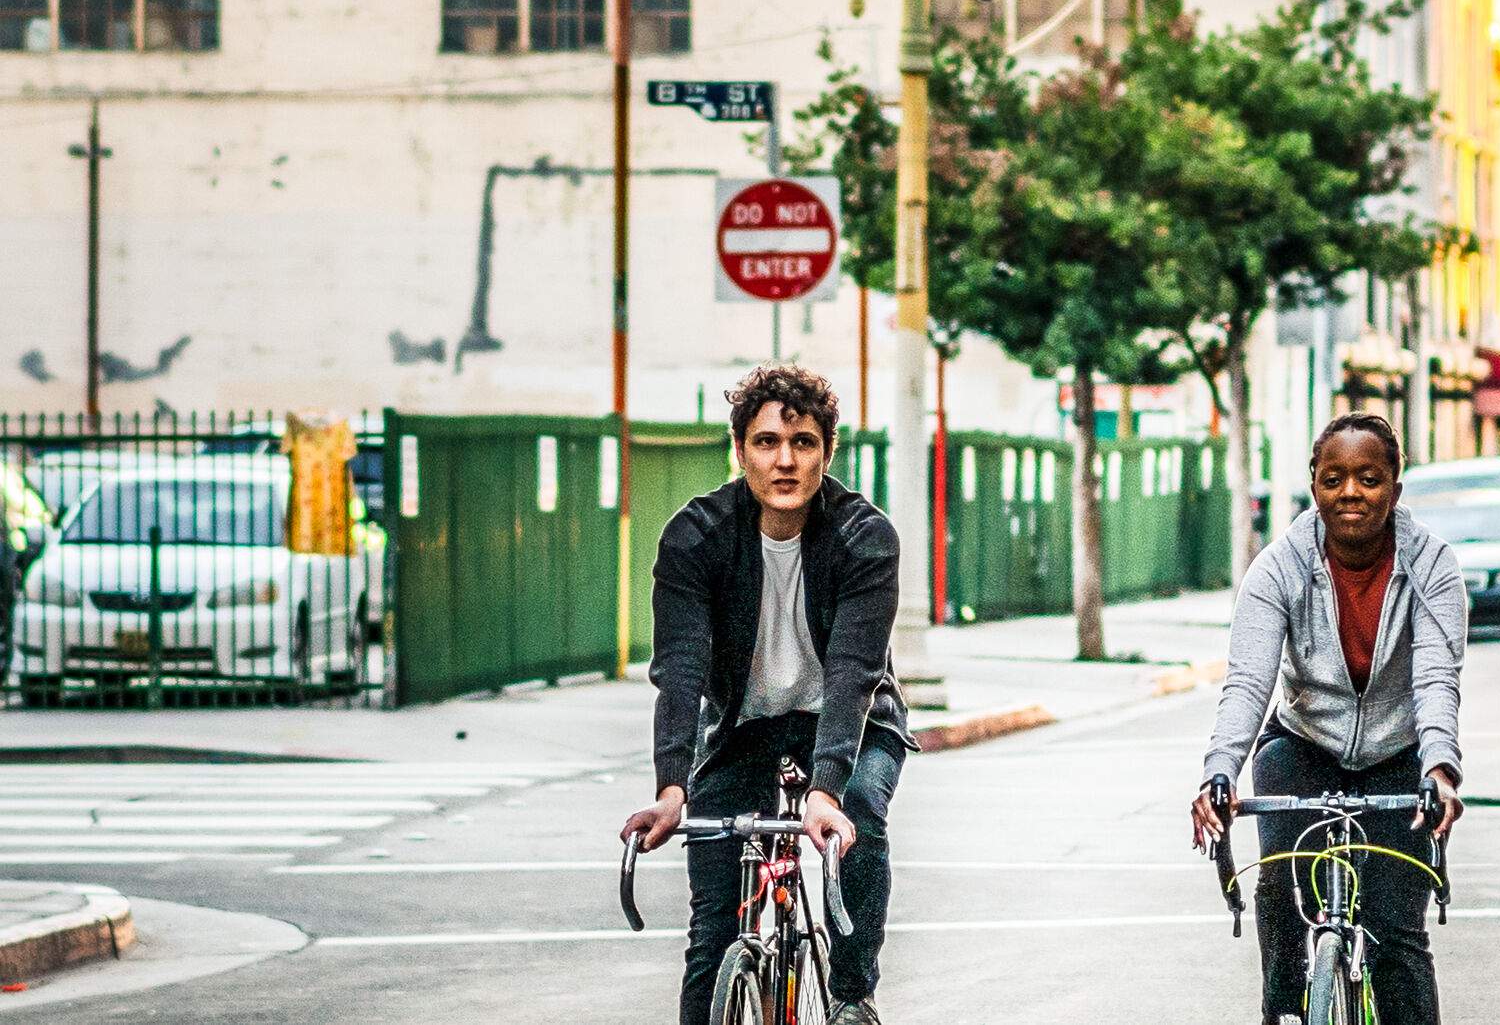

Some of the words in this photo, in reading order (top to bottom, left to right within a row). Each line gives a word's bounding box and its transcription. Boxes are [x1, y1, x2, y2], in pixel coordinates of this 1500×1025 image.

[733, 202, 763, 224] DO
[777, 202, 817, 224] NOT
[742, 257, 812, 279] ENTER
